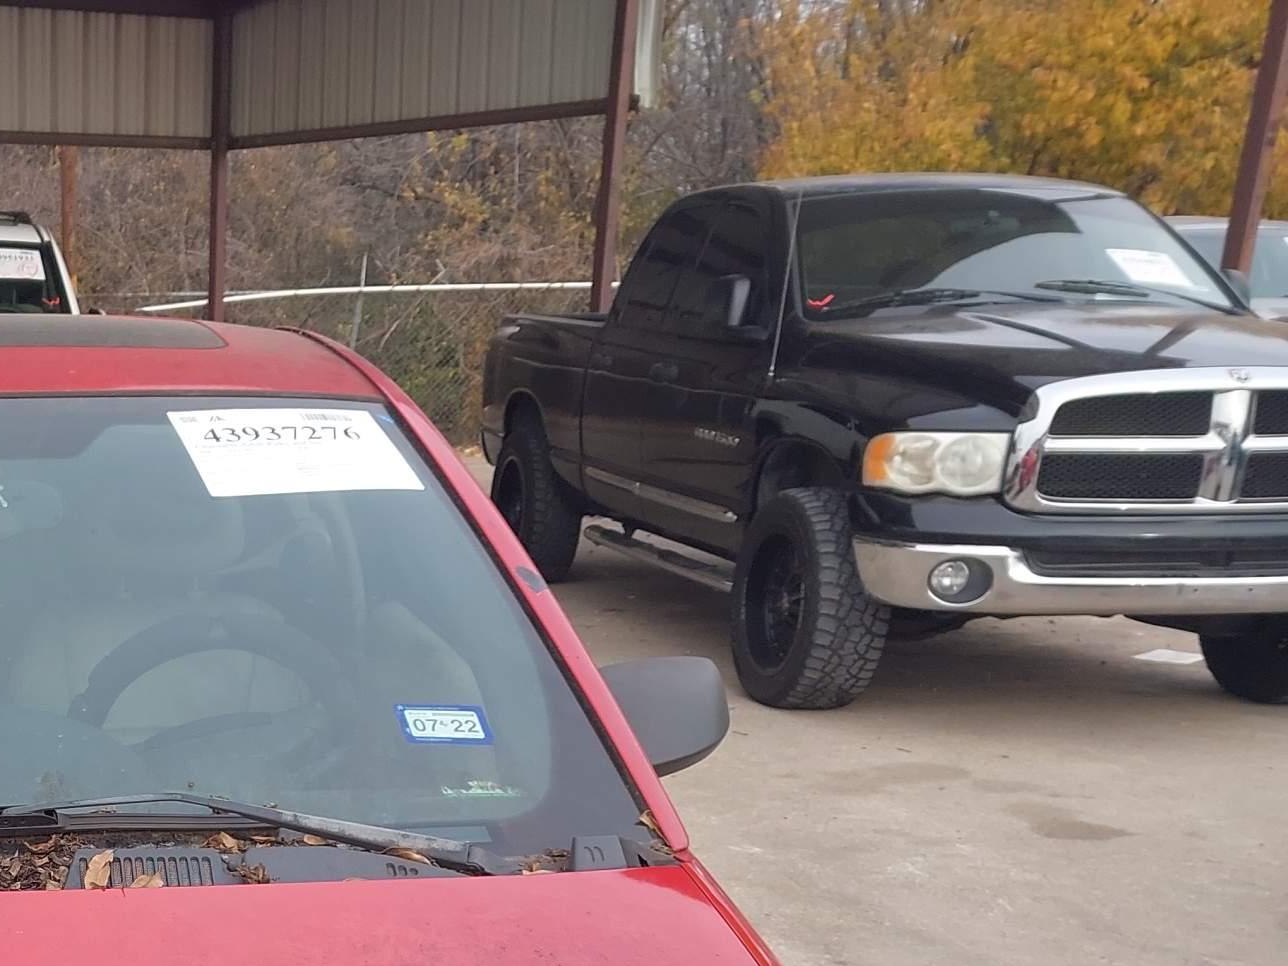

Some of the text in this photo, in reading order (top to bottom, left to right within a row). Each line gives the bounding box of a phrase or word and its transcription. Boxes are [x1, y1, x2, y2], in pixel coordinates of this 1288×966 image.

[203, 426, 361, 442] 43937276
[413, 718, 480, 733] 07 22
